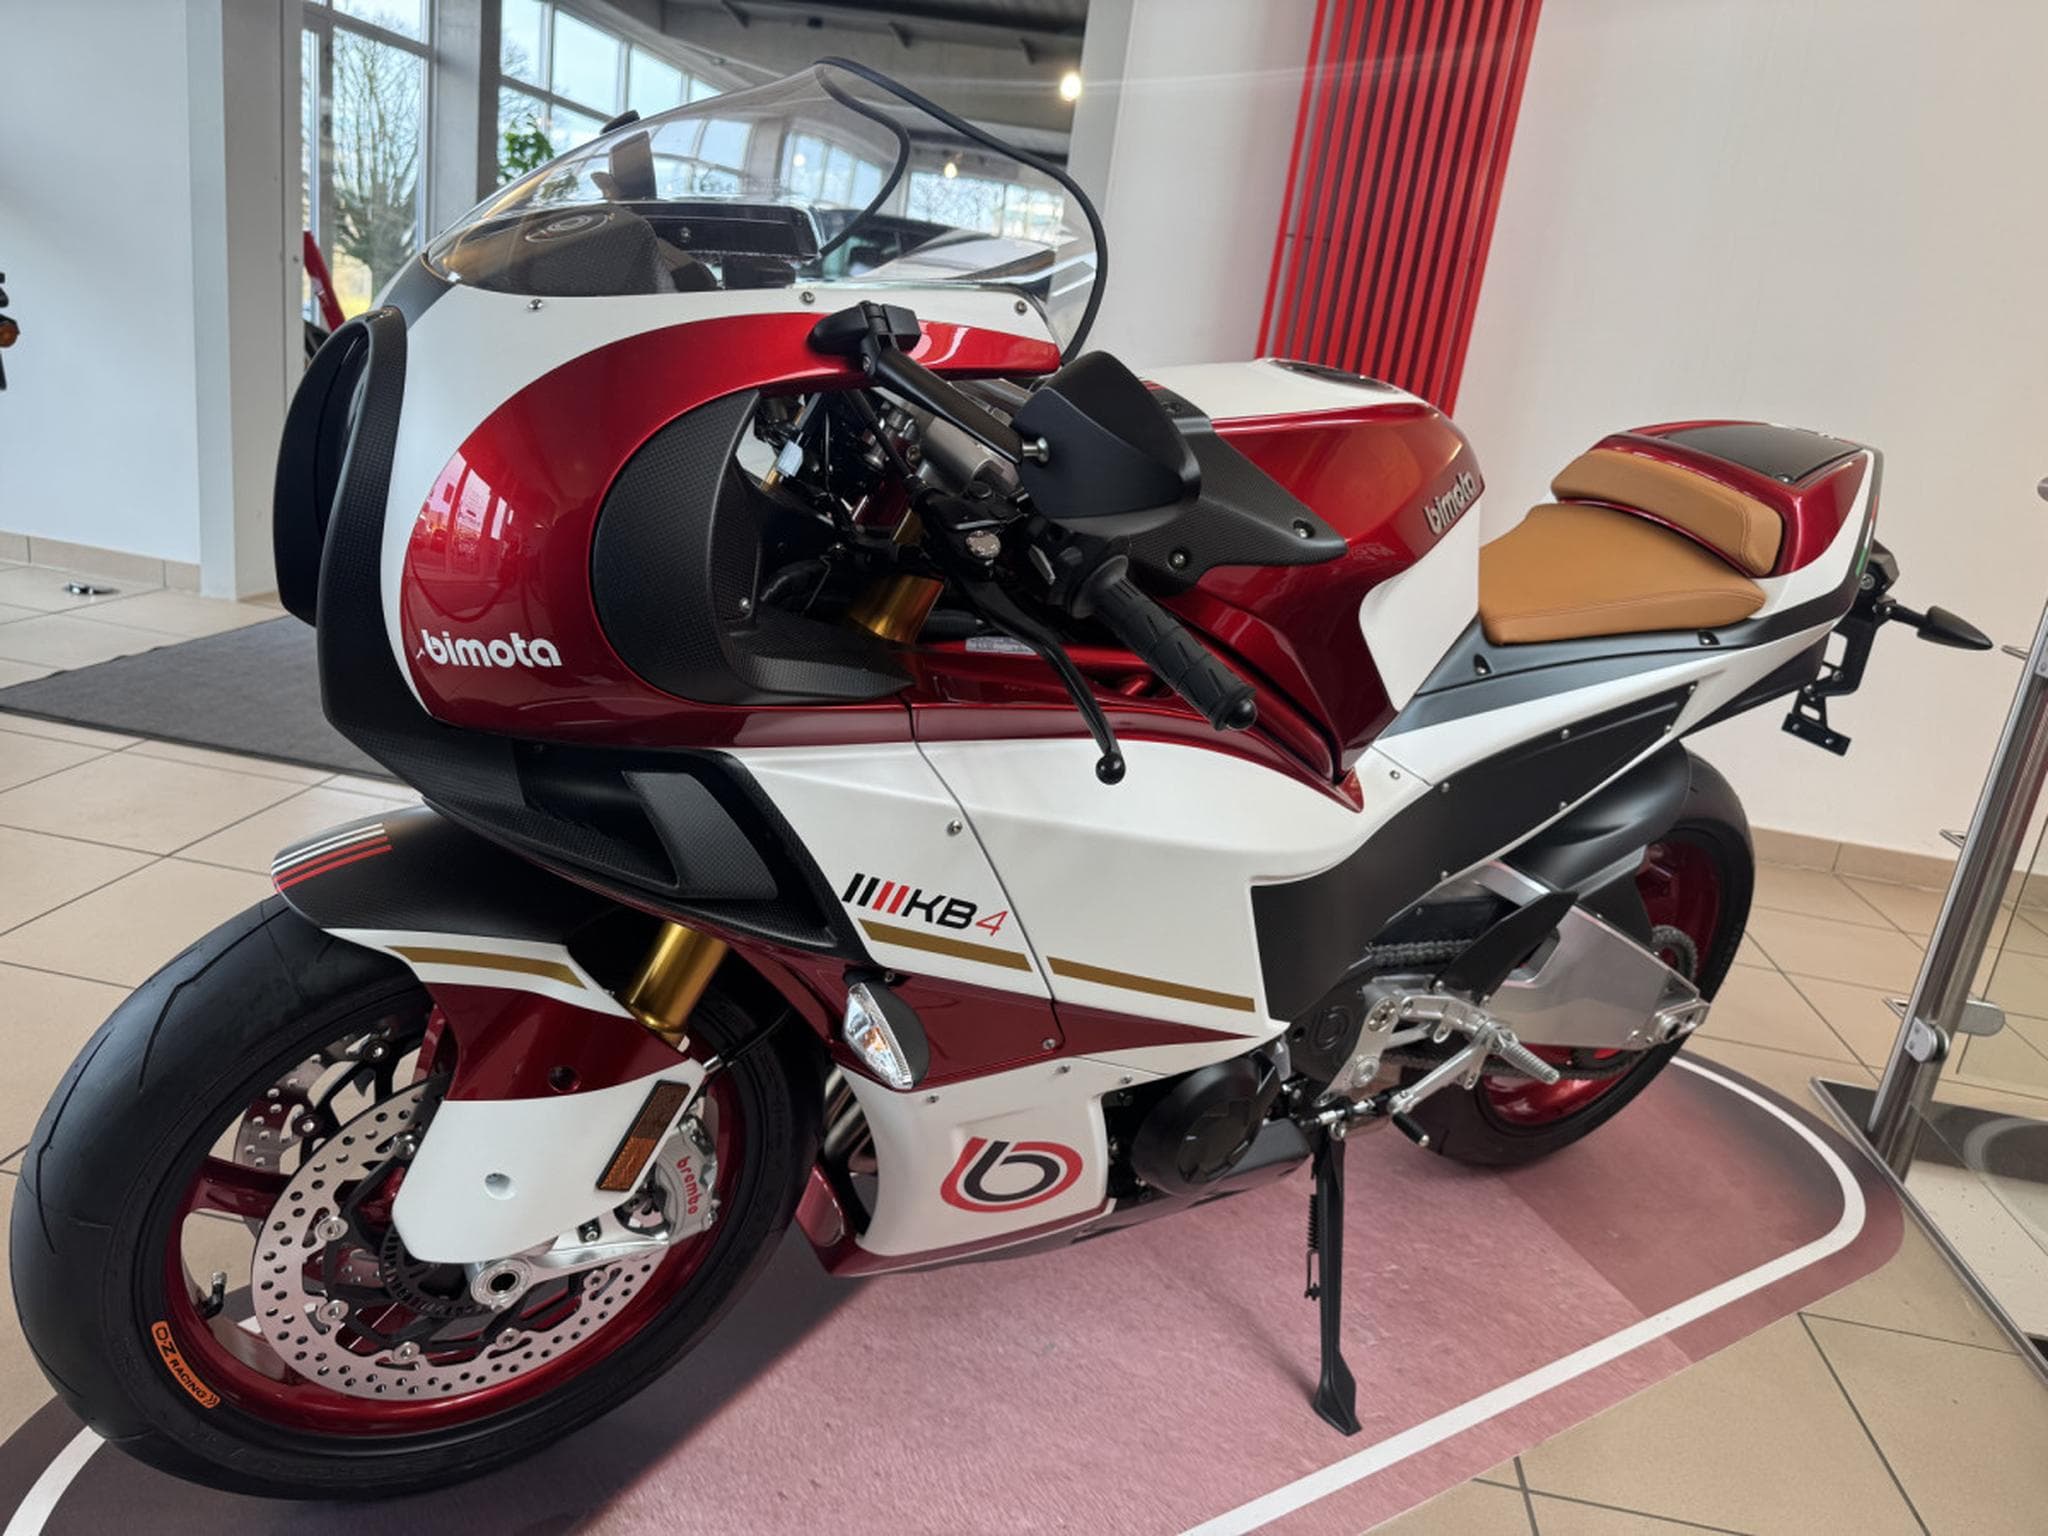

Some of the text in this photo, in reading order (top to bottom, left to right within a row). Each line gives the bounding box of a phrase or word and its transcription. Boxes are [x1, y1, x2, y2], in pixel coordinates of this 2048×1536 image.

[1423, 472, 1476, 535] bimota
[421, 629, 563, 668] bimota
[901, 889, 1009, 936] KB4
[676, 1156, 703, 1215] brembo
[170, 1359, 208, 1400] RACING
